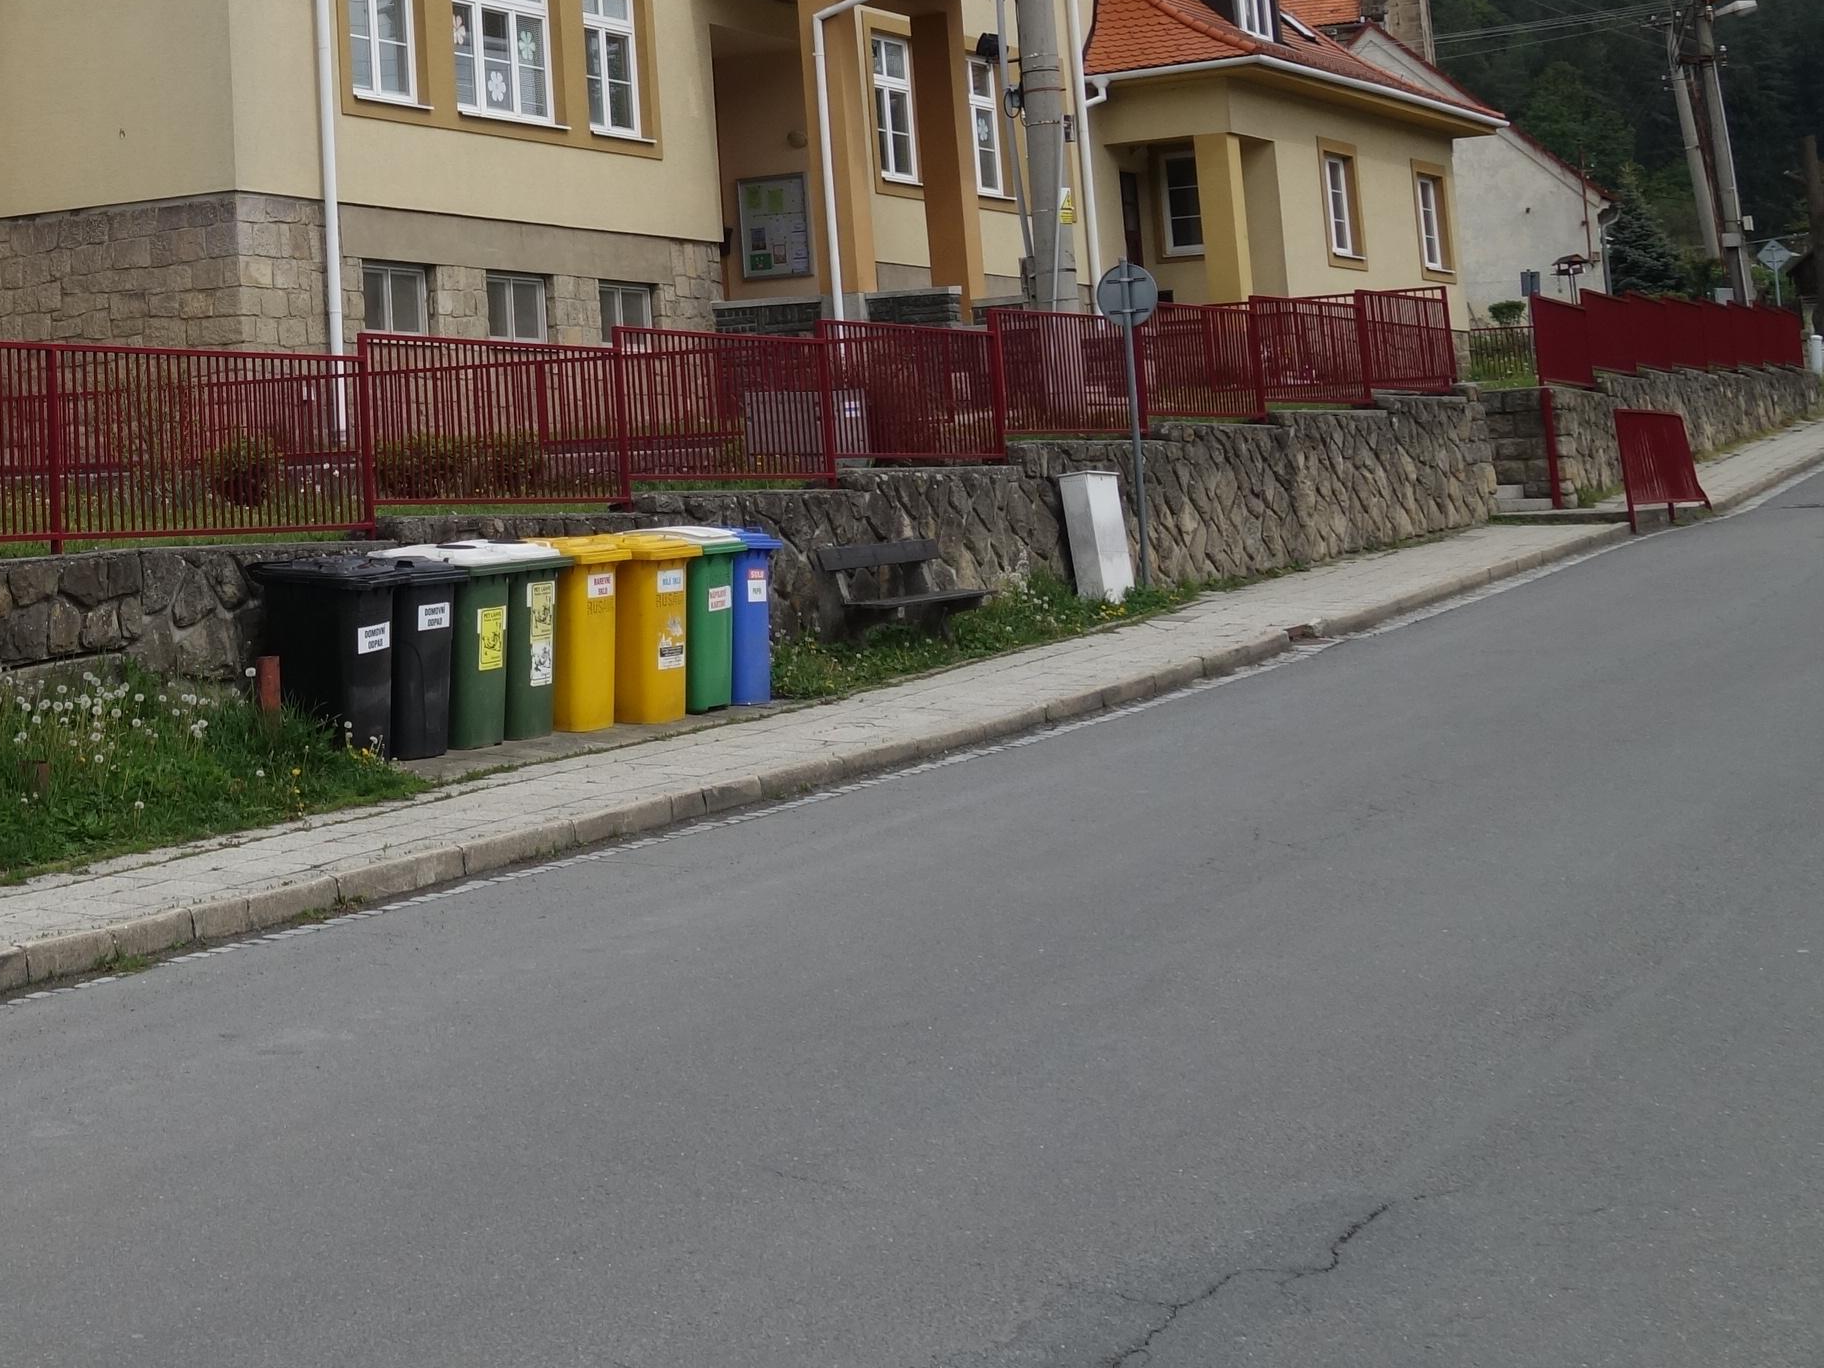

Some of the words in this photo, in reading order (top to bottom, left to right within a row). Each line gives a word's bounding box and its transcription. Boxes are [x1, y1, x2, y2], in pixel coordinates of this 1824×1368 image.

[425, 604, 445, 616] DOMOVNÍ
[427, 617, 443, 627] ODPAD
[365, 624, 385, 639] DOMOVNÍ
[368, 638, 383, 650] ODPAD
